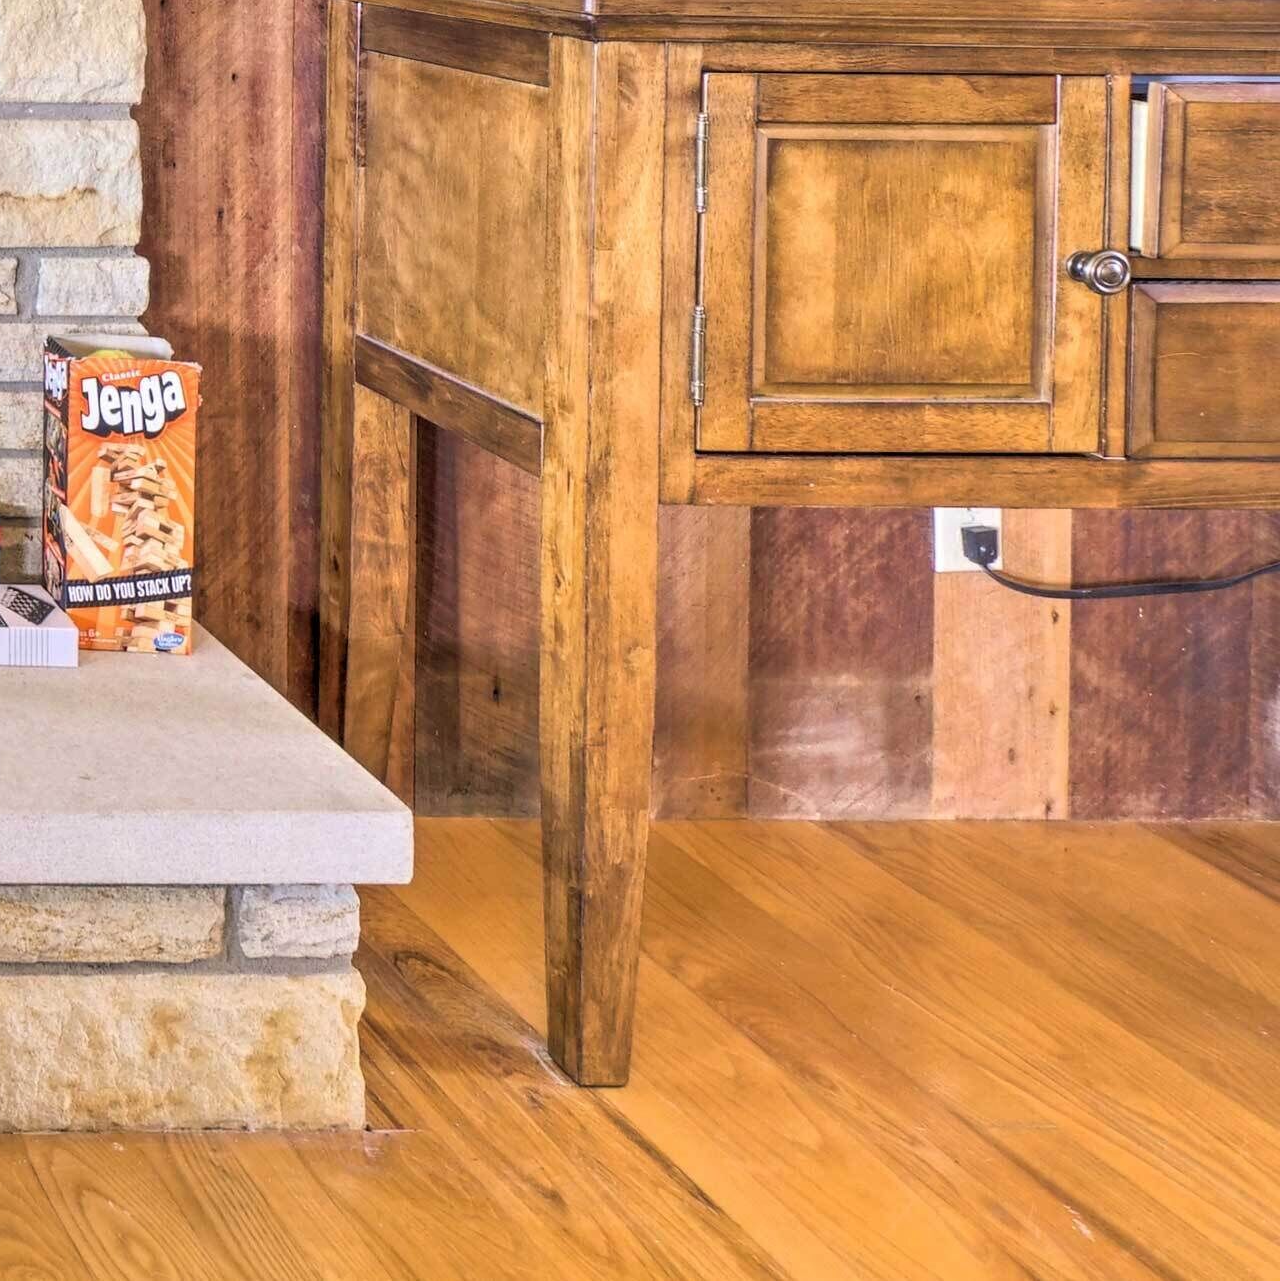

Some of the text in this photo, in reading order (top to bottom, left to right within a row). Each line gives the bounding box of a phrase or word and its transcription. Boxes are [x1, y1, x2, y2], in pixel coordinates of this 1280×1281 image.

[101, 370, 142, 383] Classic
[81, 370, 187, 435] Jenga
[67, 574, 192, 603] HOW DO YOU STACK UP?
